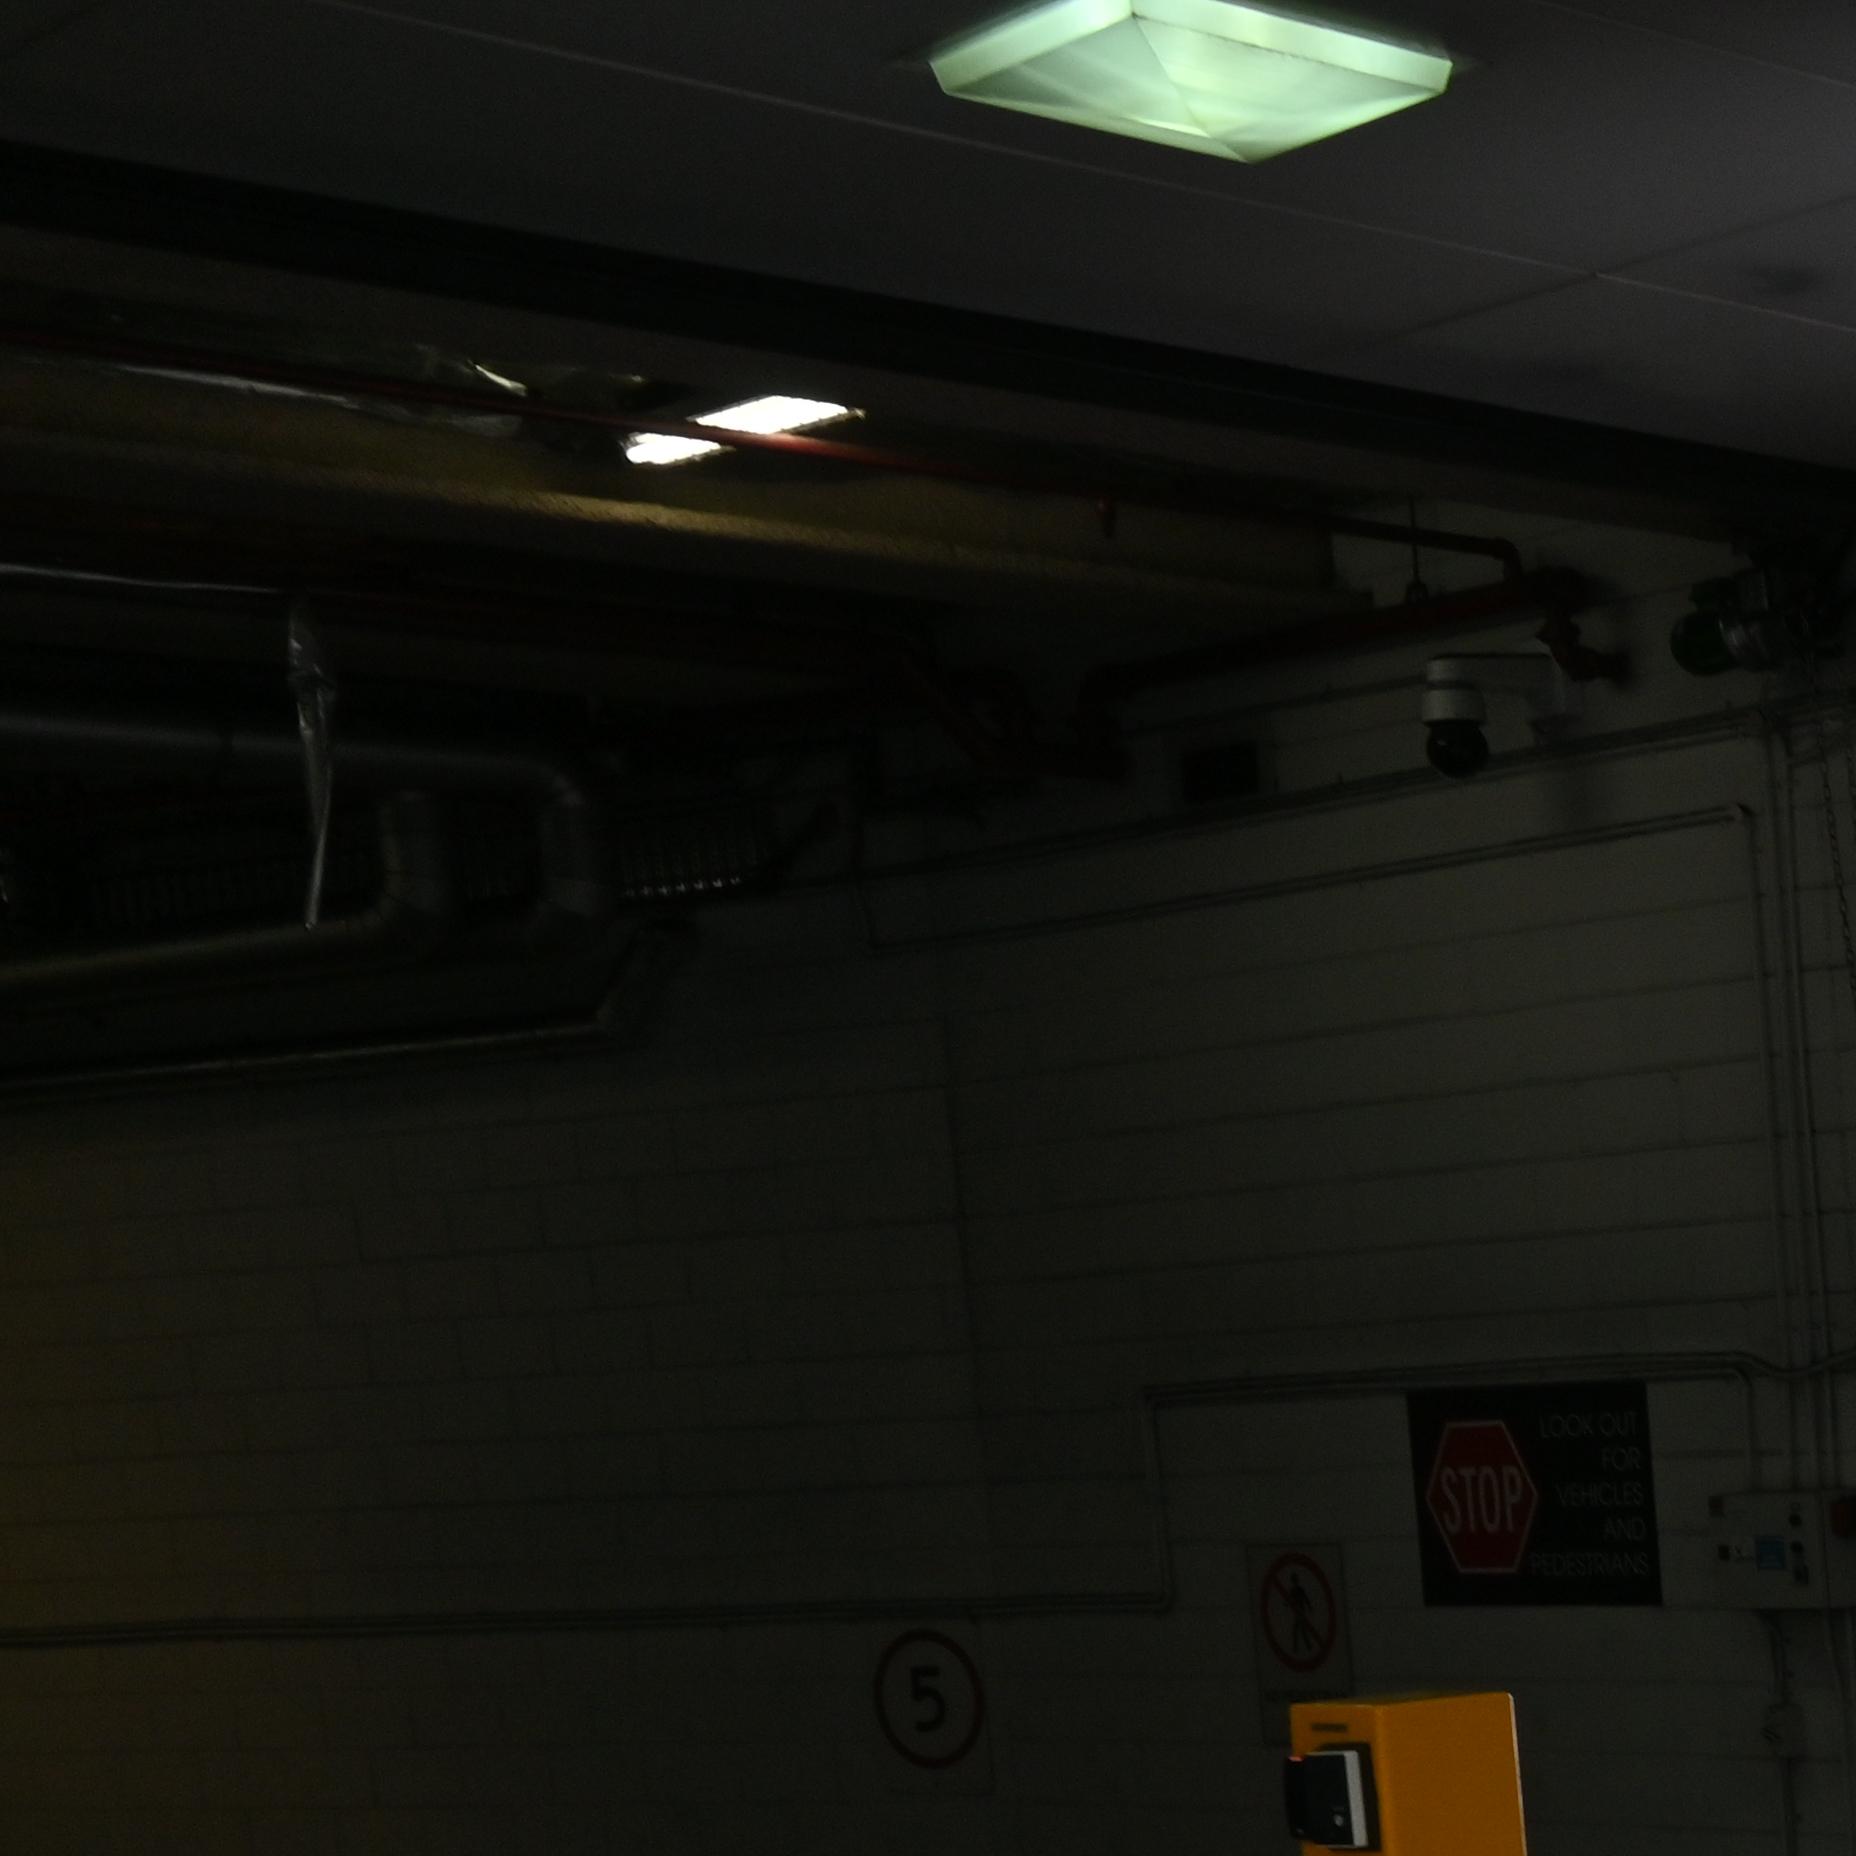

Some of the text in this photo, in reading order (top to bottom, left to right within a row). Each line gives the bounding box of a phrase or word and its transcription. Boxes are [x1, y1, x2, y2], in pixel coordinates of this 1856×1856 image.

[1538, 1411, 1639, 1440] LOOK OUT
[1601, 1446, 1642, 1473] FOR
[1440, 1464, 1524, 1536] STOP
[1554, 1479, 1645, 1507] VEHICLES
[1602, 1516, 1647, 1543] AND
[1529, 1550, 1650, 1577] PEDESTRIANS
[910, 1665, 947, 1732] 5
